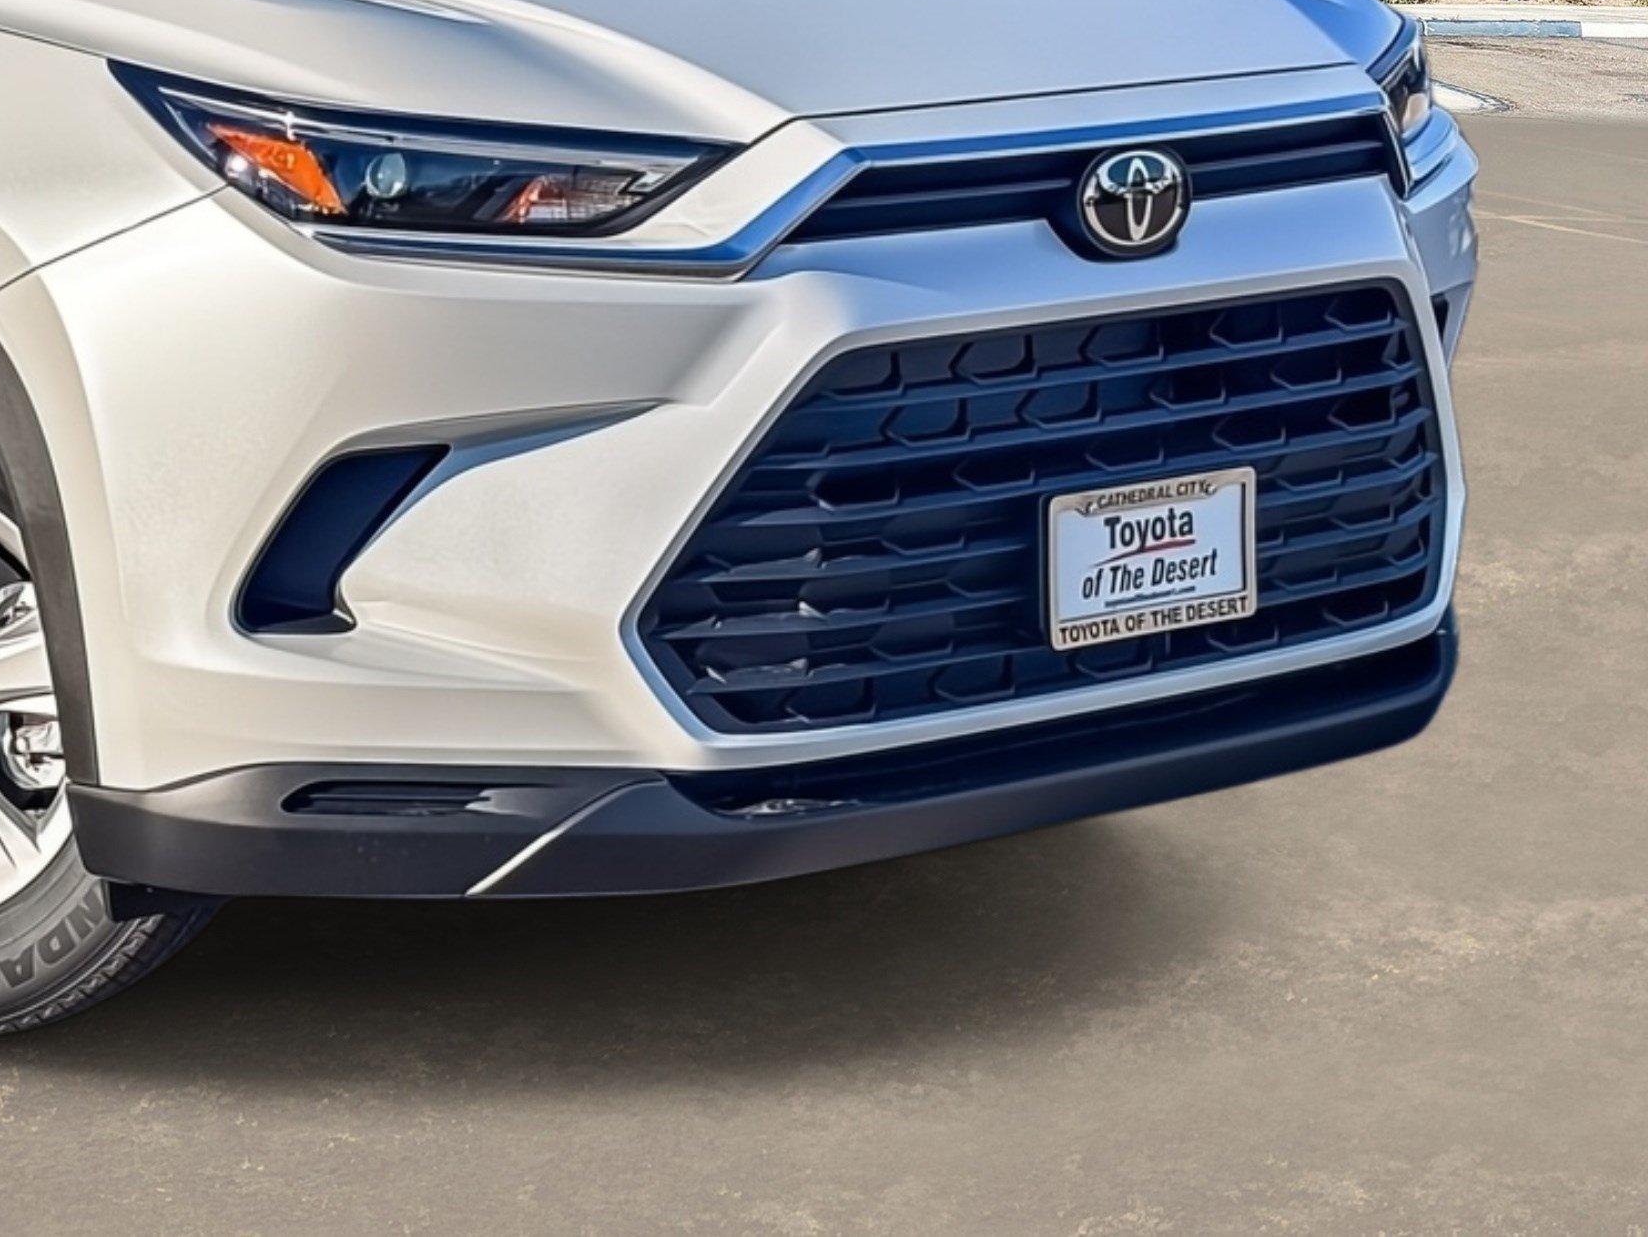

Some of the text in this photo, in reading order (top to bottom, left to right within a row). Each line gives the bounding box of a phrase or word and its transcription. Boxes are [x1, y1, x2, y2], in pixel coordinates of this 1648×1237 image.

[1096, 480, 1207, 510] CATHEDRAL CITY
[1104, 508, 1194, 549] Toyota
[1082, 568, 1104, 599] of
[1110, 564, 1145, 593] The
[1151, 549, 1218, 586] Desert
[1059, 620, 1120, 644] TOYOTA
[1125, 614, 1146, 631] OF
[1151, 607, 1183, 625] THE
[1186, 596, 1249, 622] DESERT
